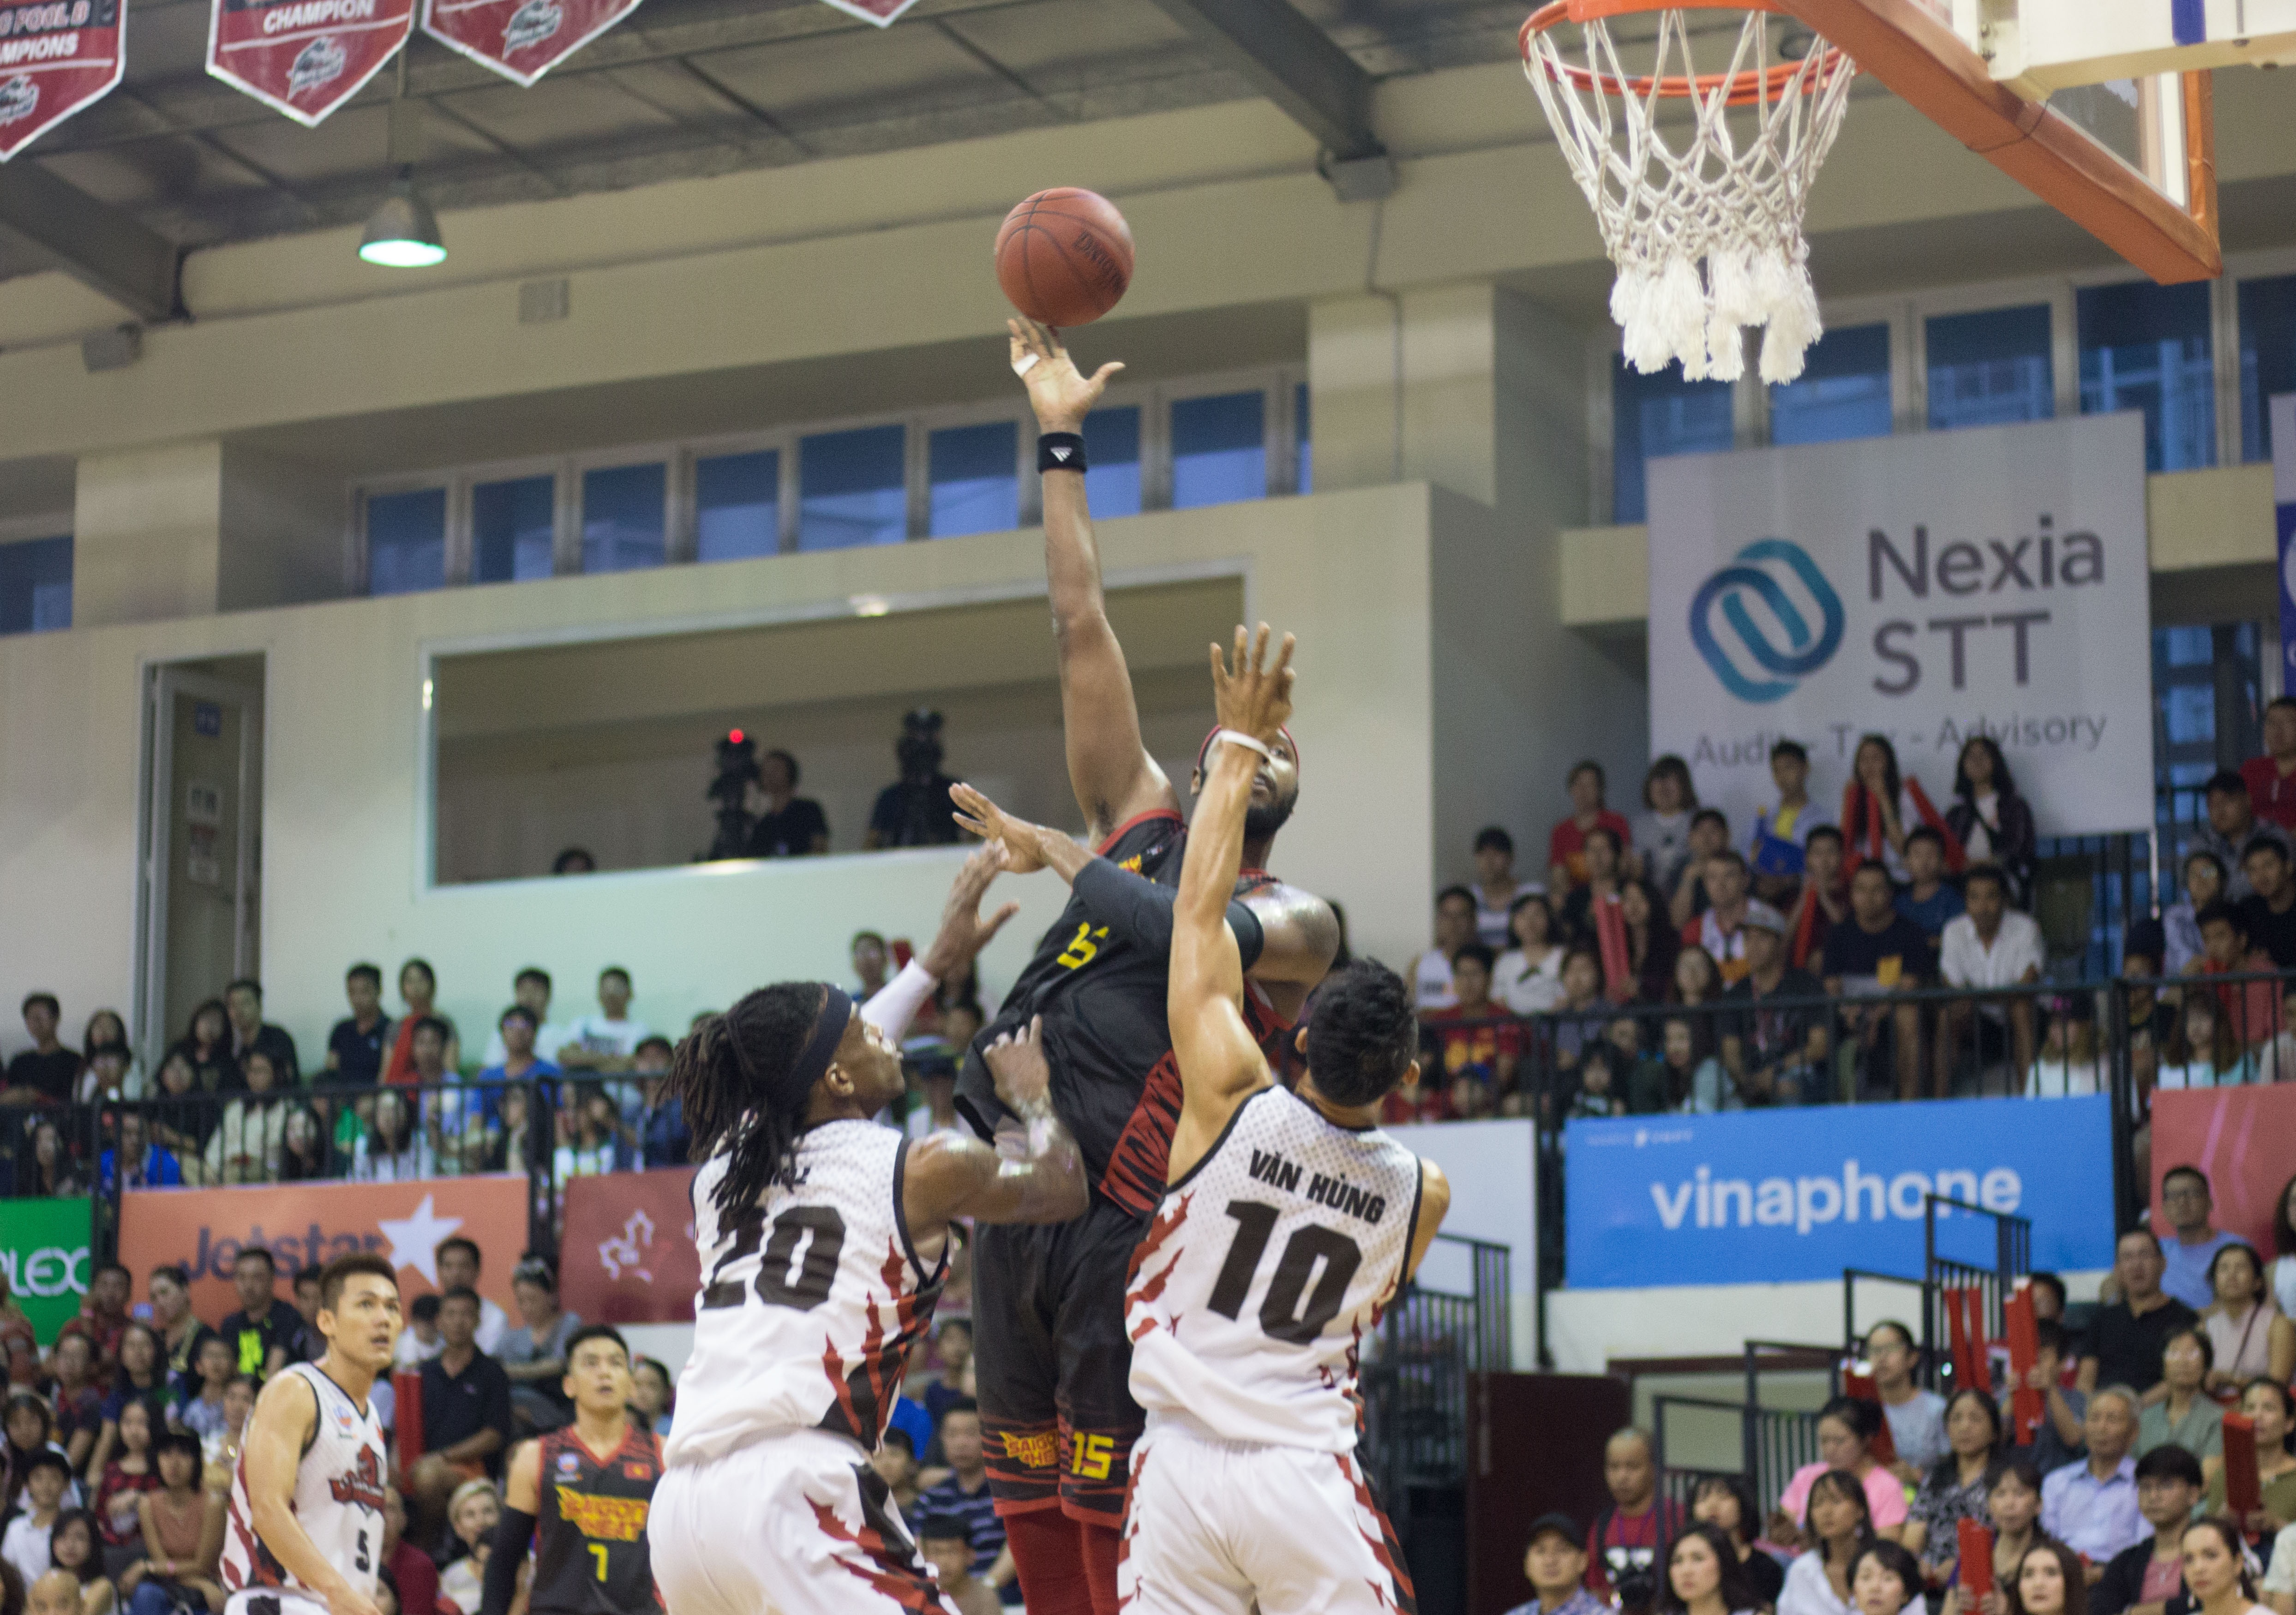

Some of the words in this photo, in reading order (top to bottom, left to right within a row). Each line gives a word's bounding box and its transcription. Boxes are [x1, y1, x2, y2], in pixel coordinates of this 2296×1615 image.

[263, 0, 376, 34] CHAMPION
[0, 32, 79, 63] MPIONS
[1869, 513, 2105, 601] Nexia
[1872, 608, 2051, 695] STT
[1650, 1158, 2022, 1236] vinaphone
[0, 1246, 90, 1297] LEX
[701, 1205, 847, 1313] 20
[1207, 1199, 1364, 1347] 10
[1001, 1431, 1058, 1457] SAIGO
[1072, 1431, 1114, 1479] 15
[355, 1528, 371, 1573] 5
[587, 1543, 608, 1583] 7
